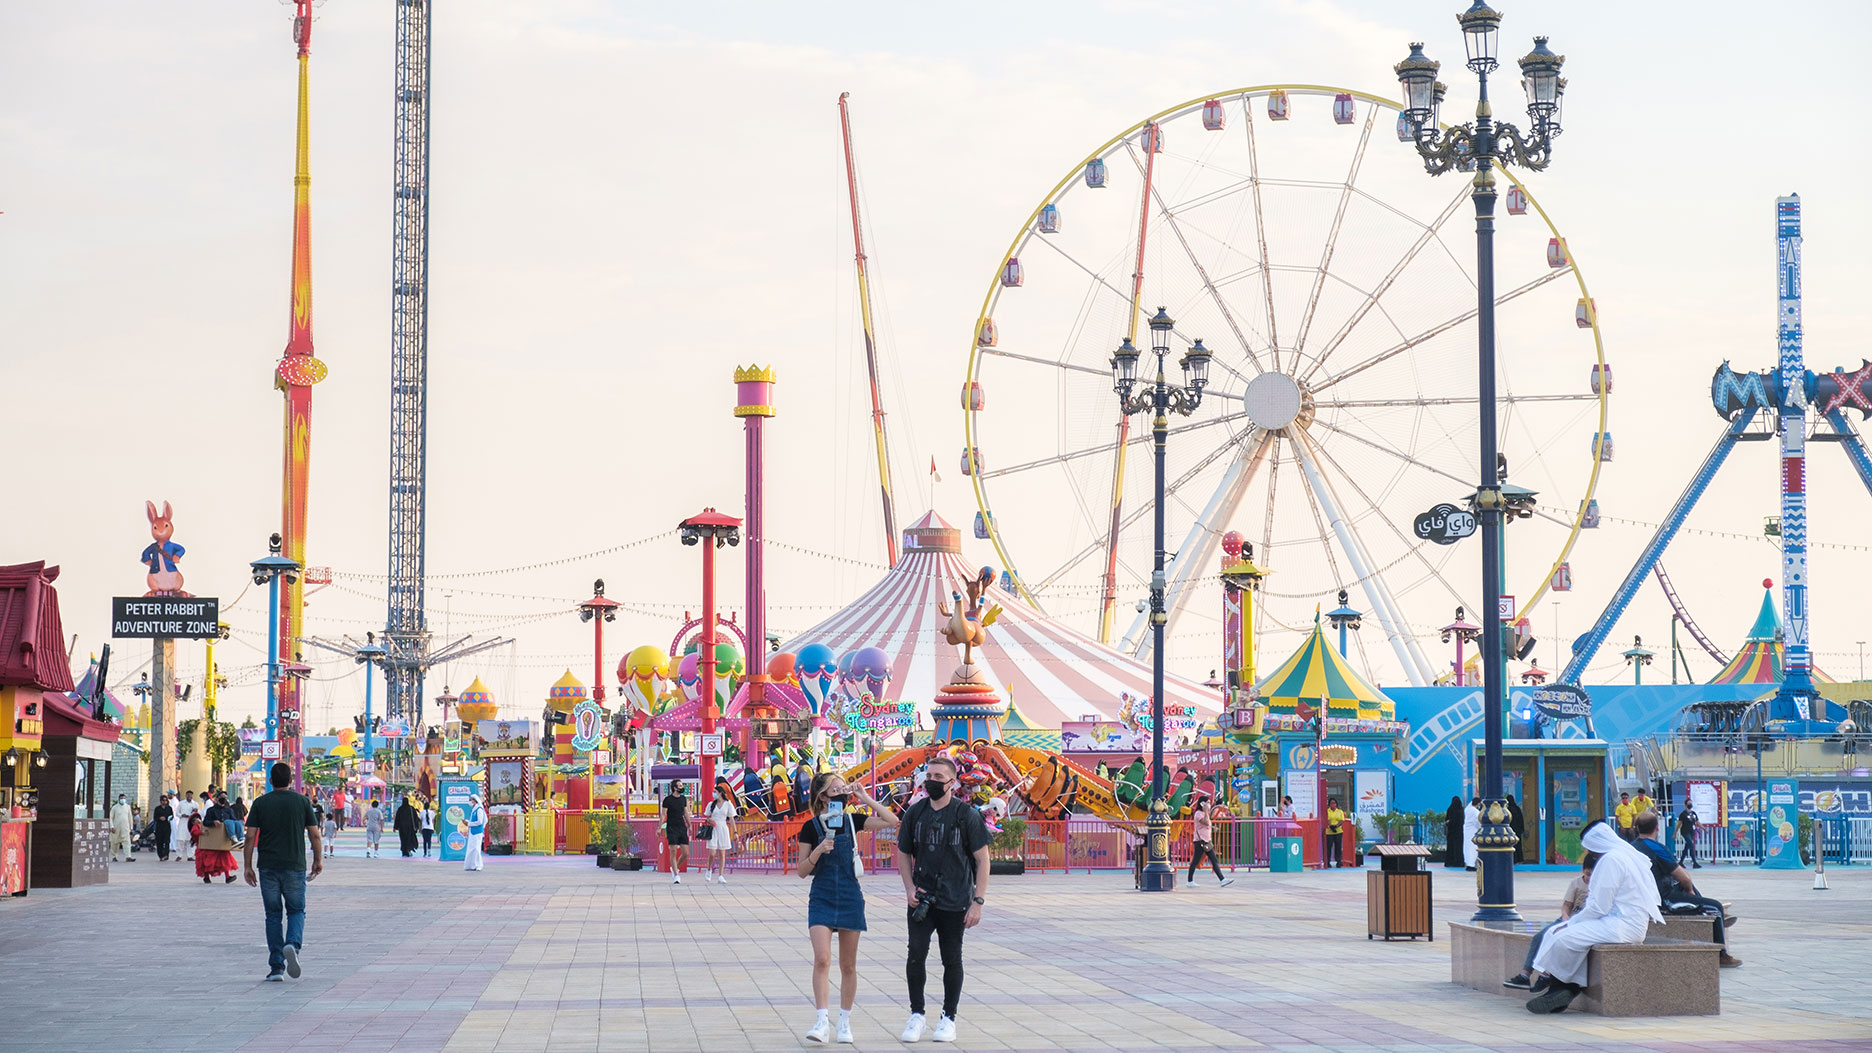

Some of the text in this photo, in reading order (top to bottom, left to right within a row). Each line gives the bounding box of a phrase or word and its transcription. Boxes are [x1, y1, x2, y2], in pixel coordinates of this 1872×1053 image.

[1714, 361, 1872, 417] MAX
[1418, 515, 1474, 537] واي فاي
[126, 603, 161, 615] PETER
[165, 603, 205, 616] RABBIT
[115, 621, 216, 634] ADVENTURE ZONE
[860, 692, 914, 718] Sydney
[846, 713, 914, 732] Kangaroo
[1137, 714, 1196, 732] Kagaroo
[1240, 711, 1251, 724] B
[1177, 752, 1200, 765] KIDS'
